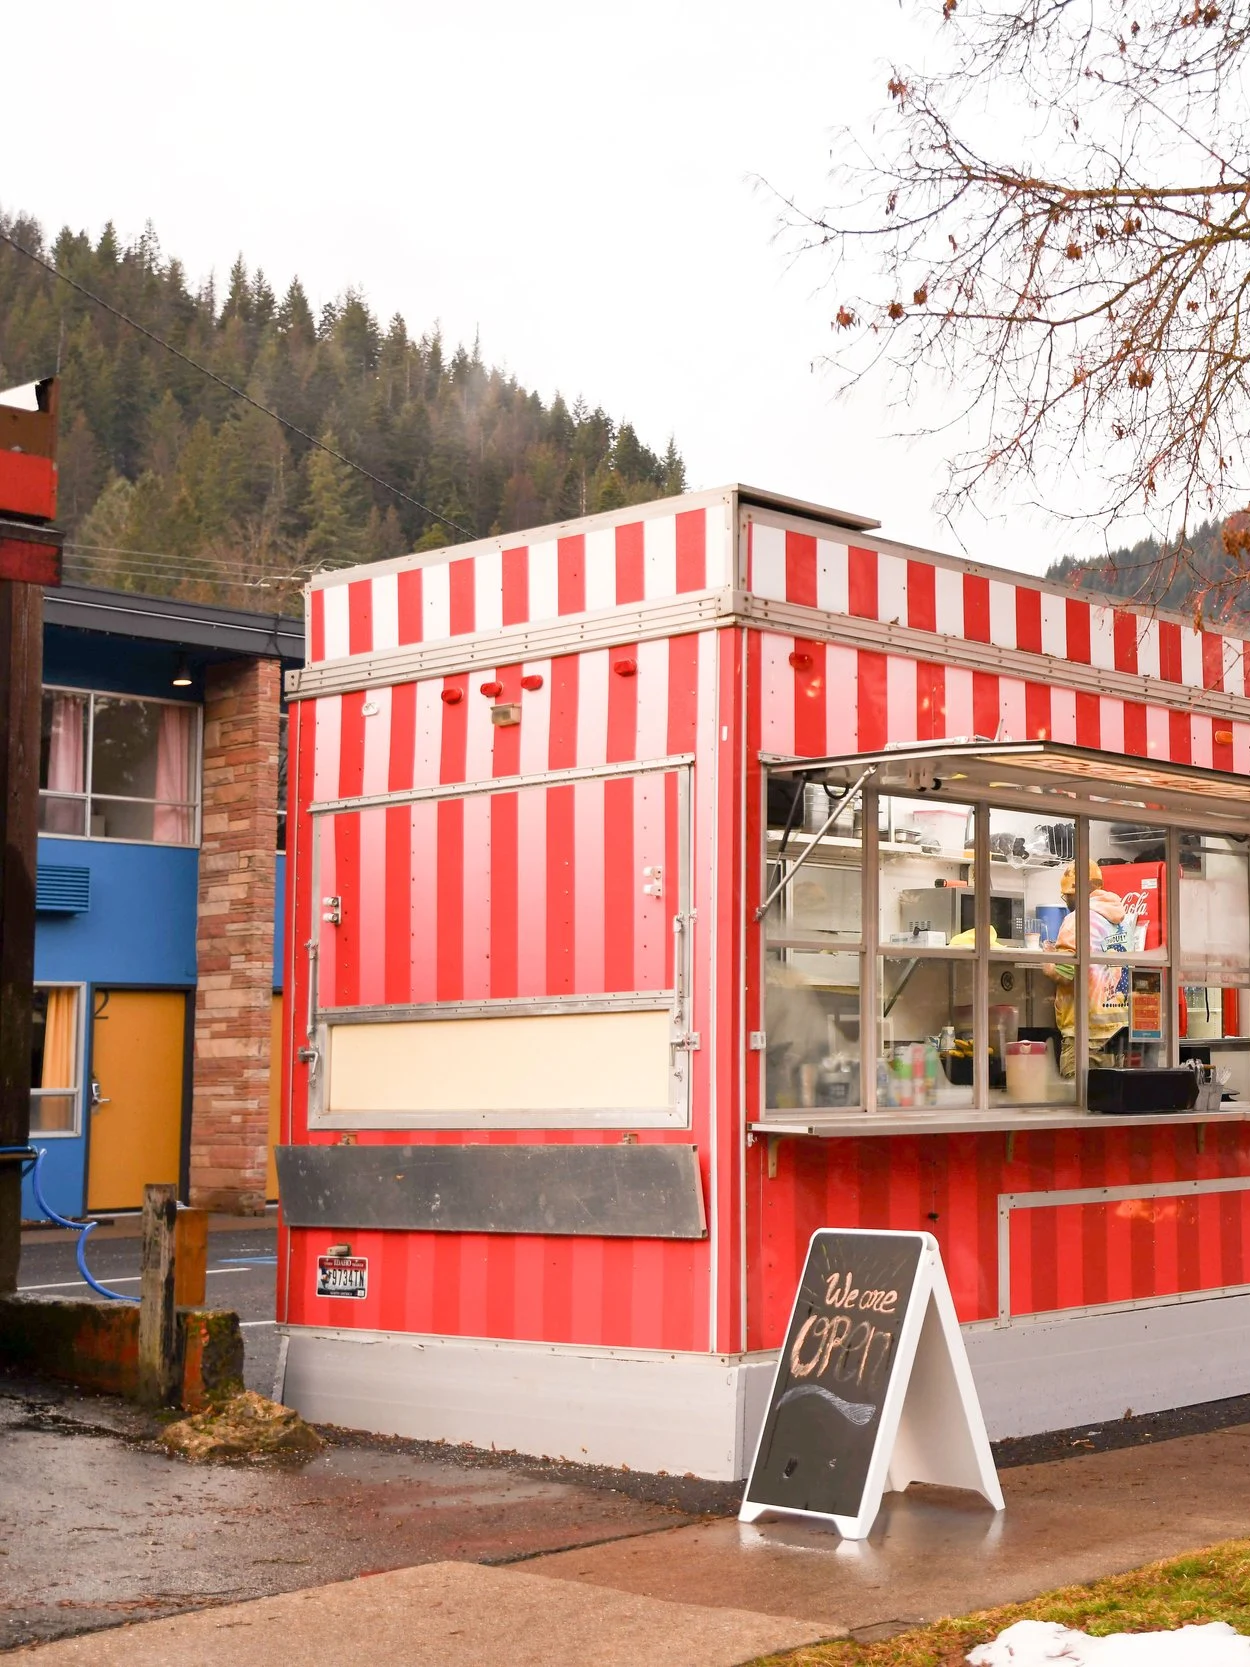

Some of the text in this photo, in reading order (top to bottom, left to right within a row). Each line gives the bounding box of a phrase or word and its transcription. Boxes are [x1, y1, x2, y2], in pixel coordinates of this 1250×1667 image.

[332, 1269, 364, 1287] 9734TN
[826, 1271, 898, 1313] We are
